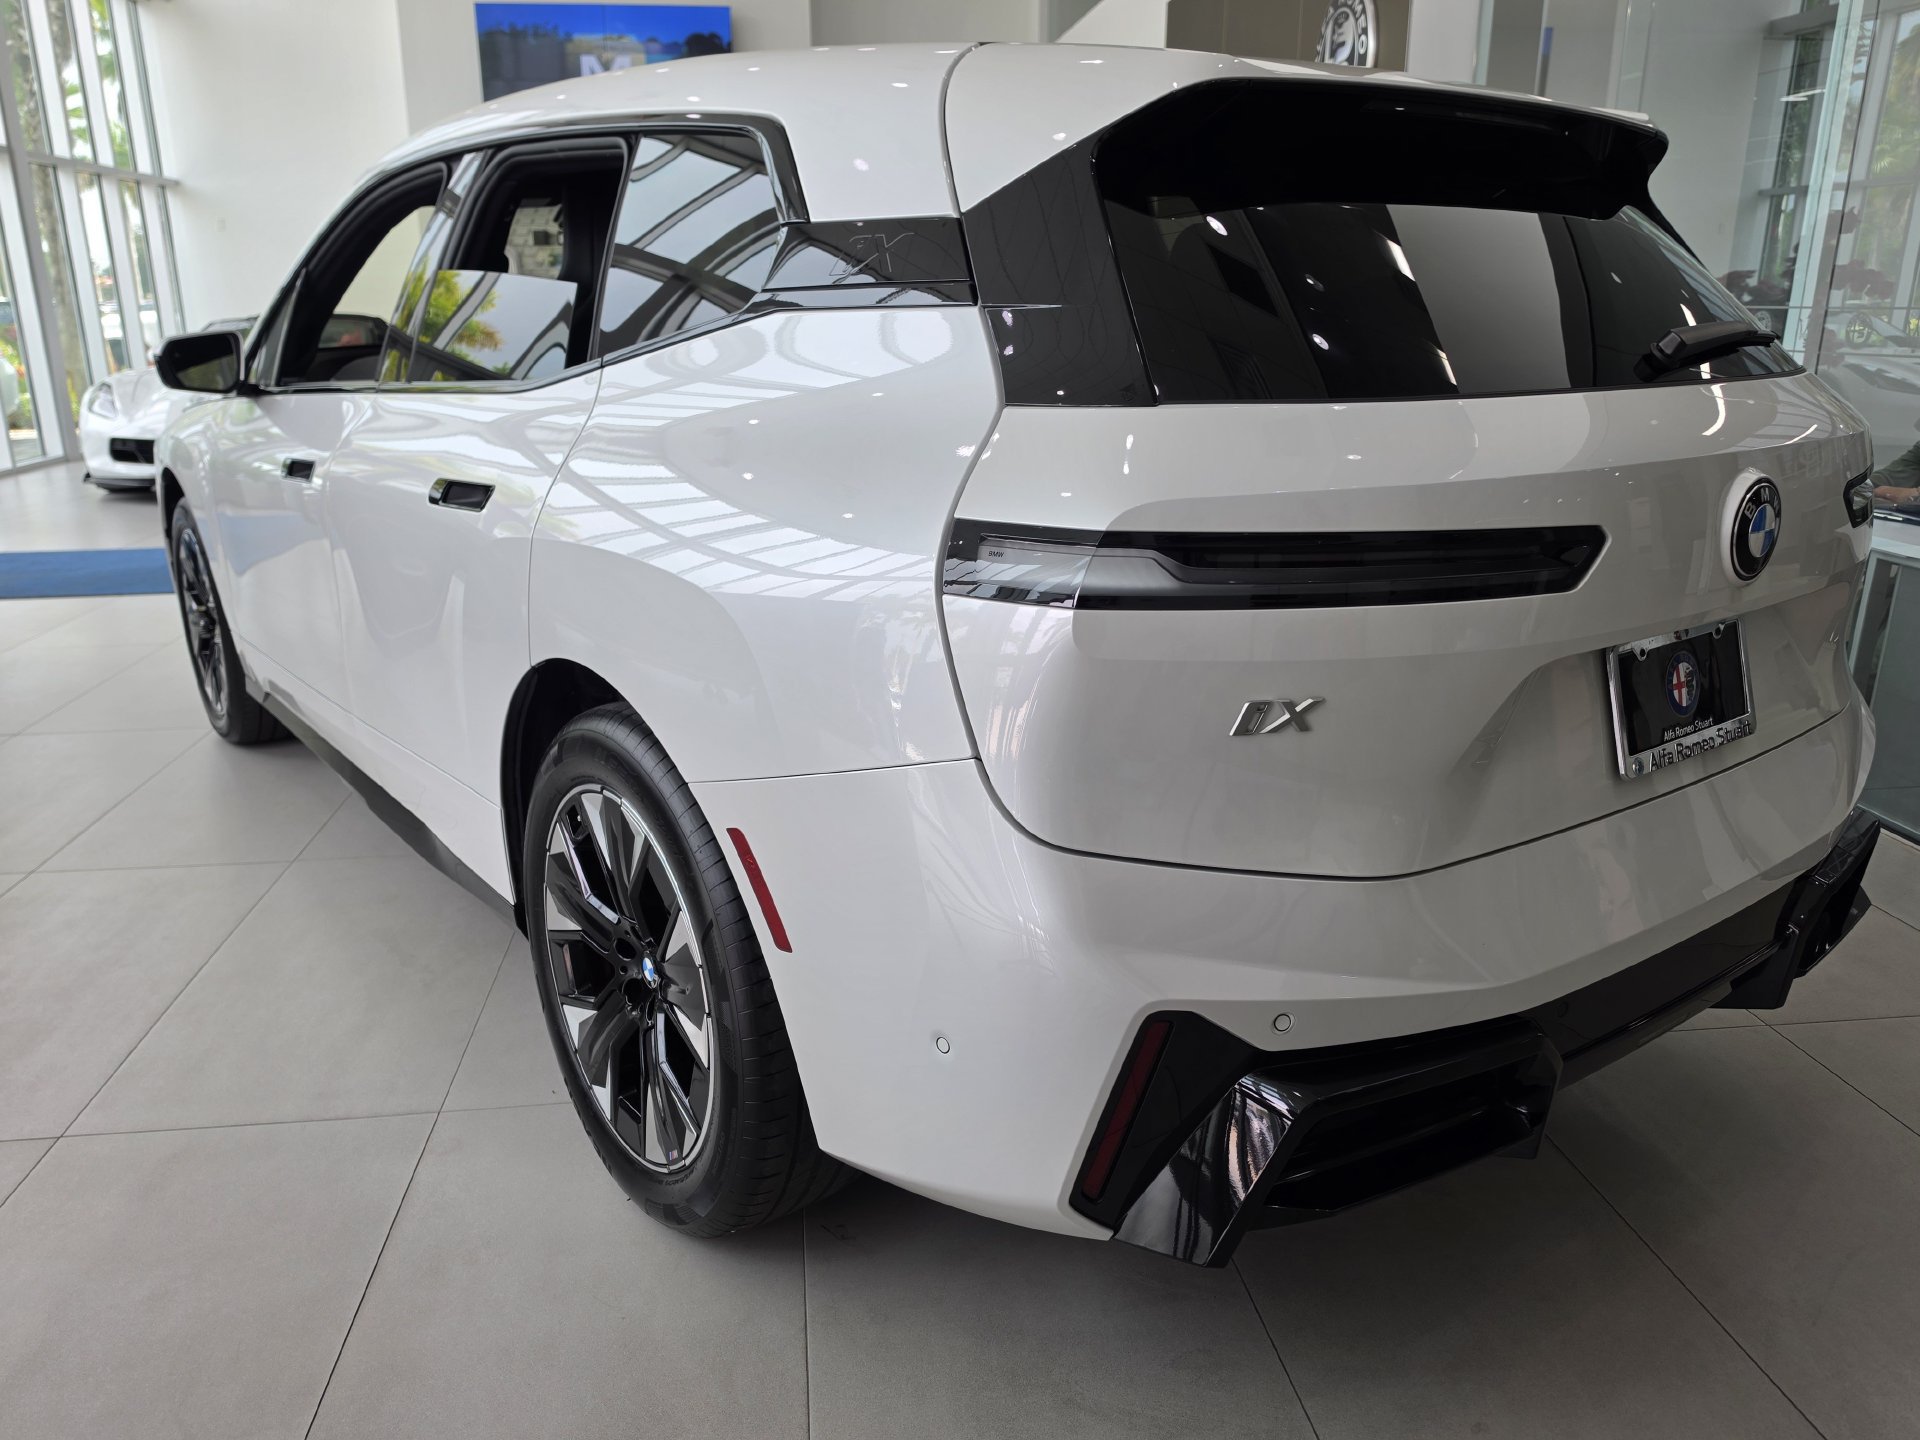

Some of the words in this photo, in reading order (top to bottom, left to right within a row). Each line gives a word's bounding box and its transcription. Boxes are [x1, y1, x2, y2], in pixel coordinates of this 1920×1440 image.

[1744, 486, 1780, 520] BMW
[988, 550, 1005, 558] BMW
[1663, 728, 1676, 742] Alfa
[1675, 725, 1695, 738] Romeo
[1694, 717, 1714, 731] Stuart
[1650, 747, 1674, 772] Alfa
[1675, 736, 1715, 762] Romeo
[1715, 720, 1751, 746] Stuart
